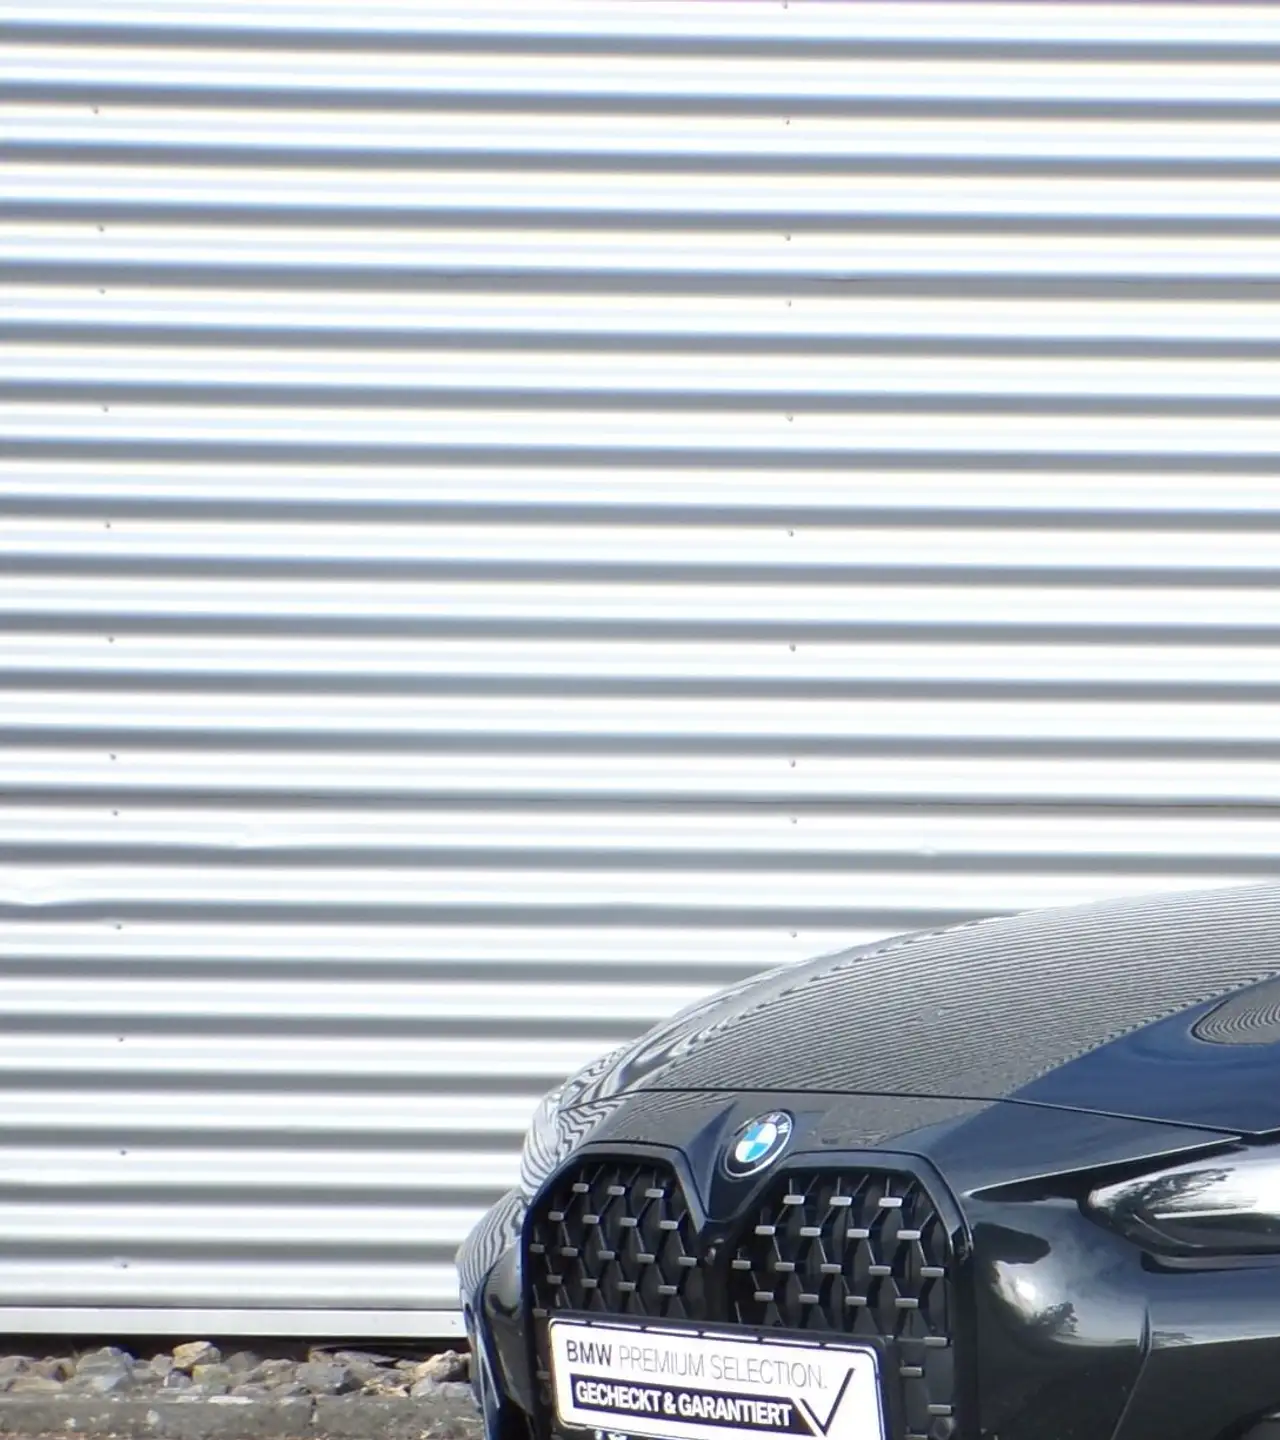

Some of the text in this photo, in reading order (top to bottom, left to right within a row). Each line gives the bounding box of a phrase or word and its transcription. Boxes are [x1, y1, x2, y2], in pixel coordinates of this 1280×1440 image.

[565, 1339, 828, 1389] BMW PREMIUM SELECTION.
[575, 1380, 792, 1426] GECHECKT & GARANTIERT
